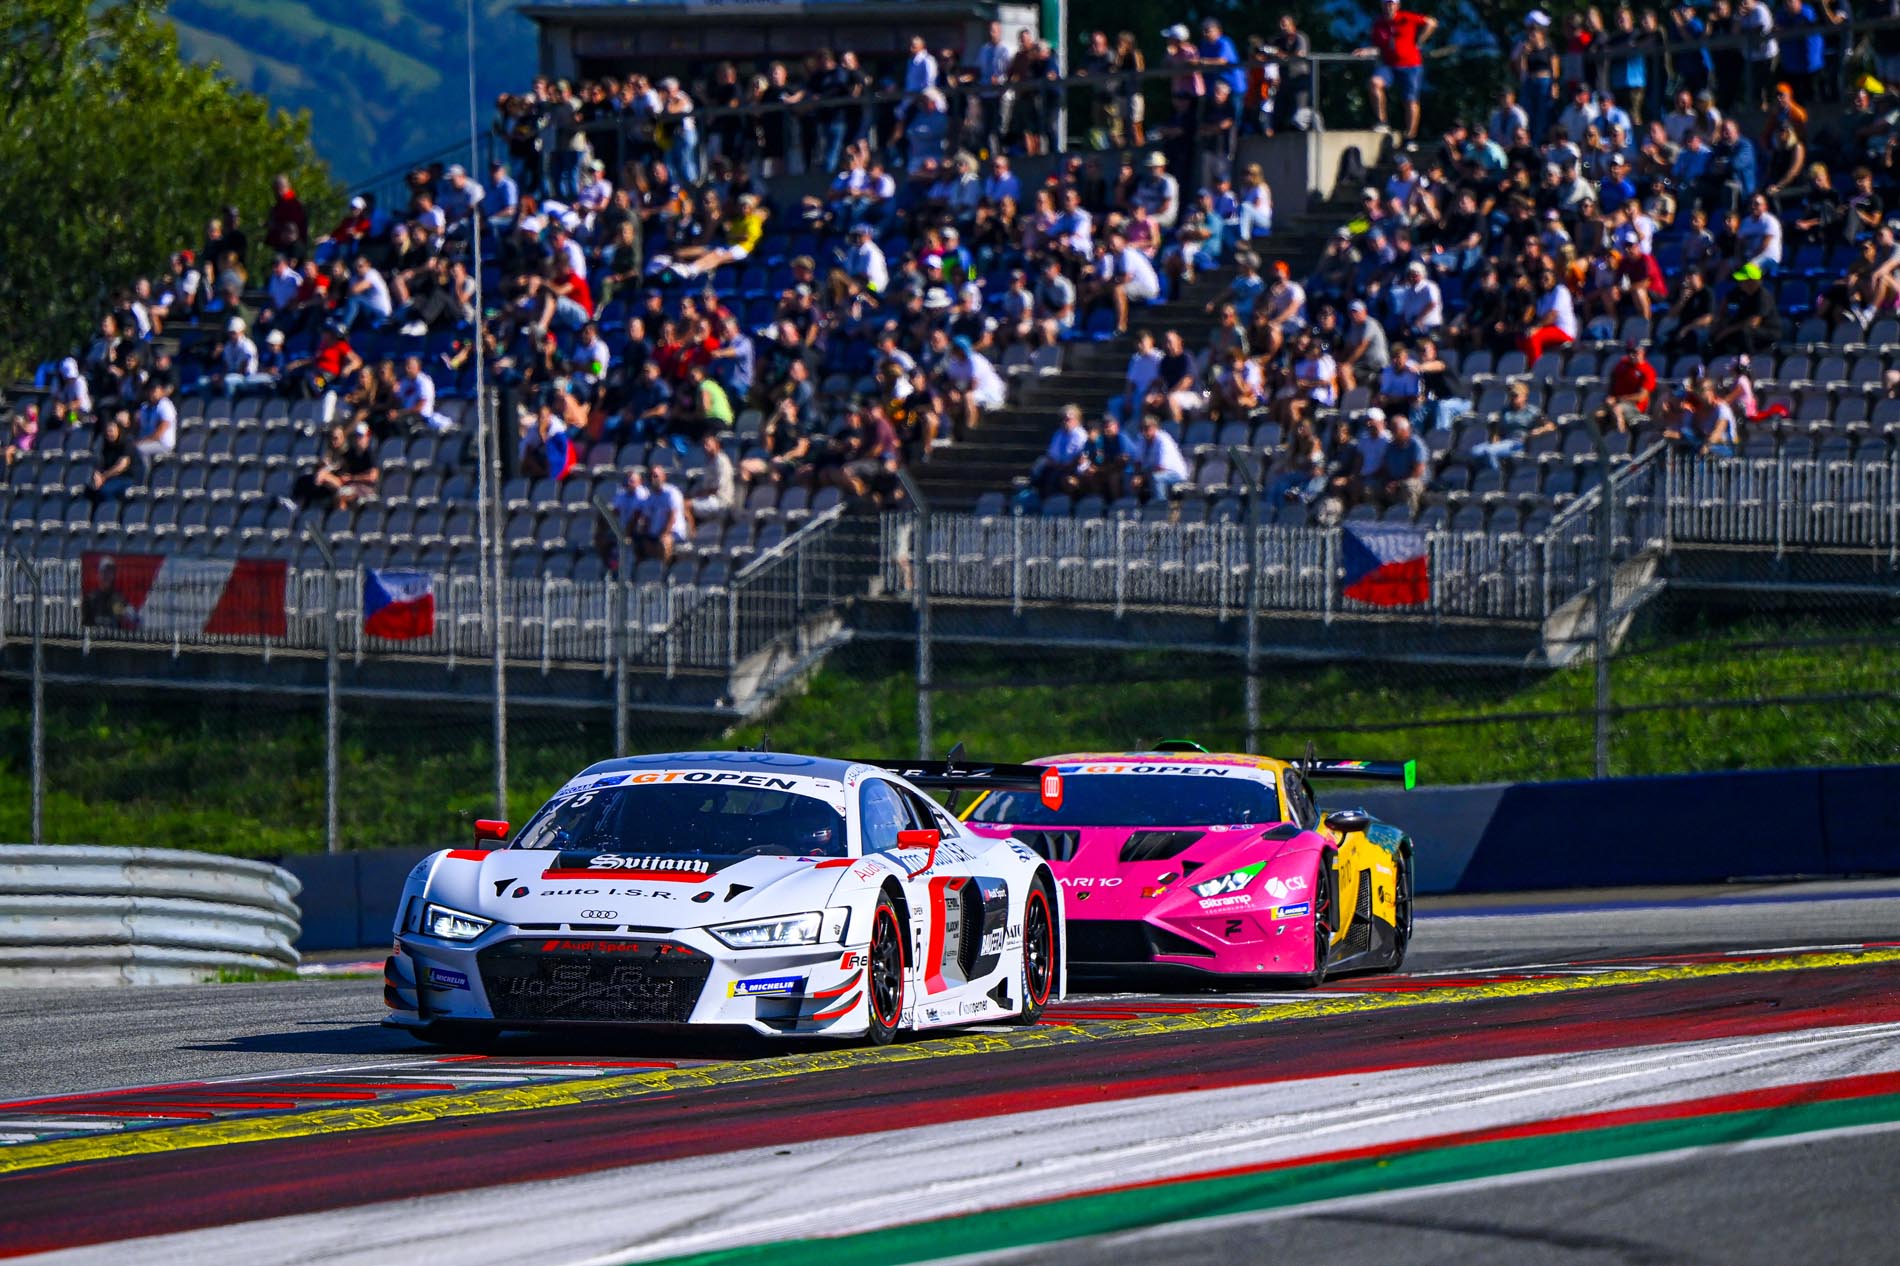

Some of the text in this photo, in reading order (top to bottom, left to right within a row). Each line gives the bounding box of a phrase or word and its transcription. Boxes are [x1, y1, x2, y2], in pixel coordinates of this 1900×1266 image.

[587, 853, 710, 874] Svijany
[1285, 875, 1308, 890] CSL
[540, 888, 678, 901] auto I.S.R.
[1198, 894, 1252, 909] Bitramp
[561, 941, 639, 954] Audi Sport
[848, 955, 868, 967] R8
[436, 973, 465, 985] MICHELIN
[748, 981, 795, 992] MICHELIN
